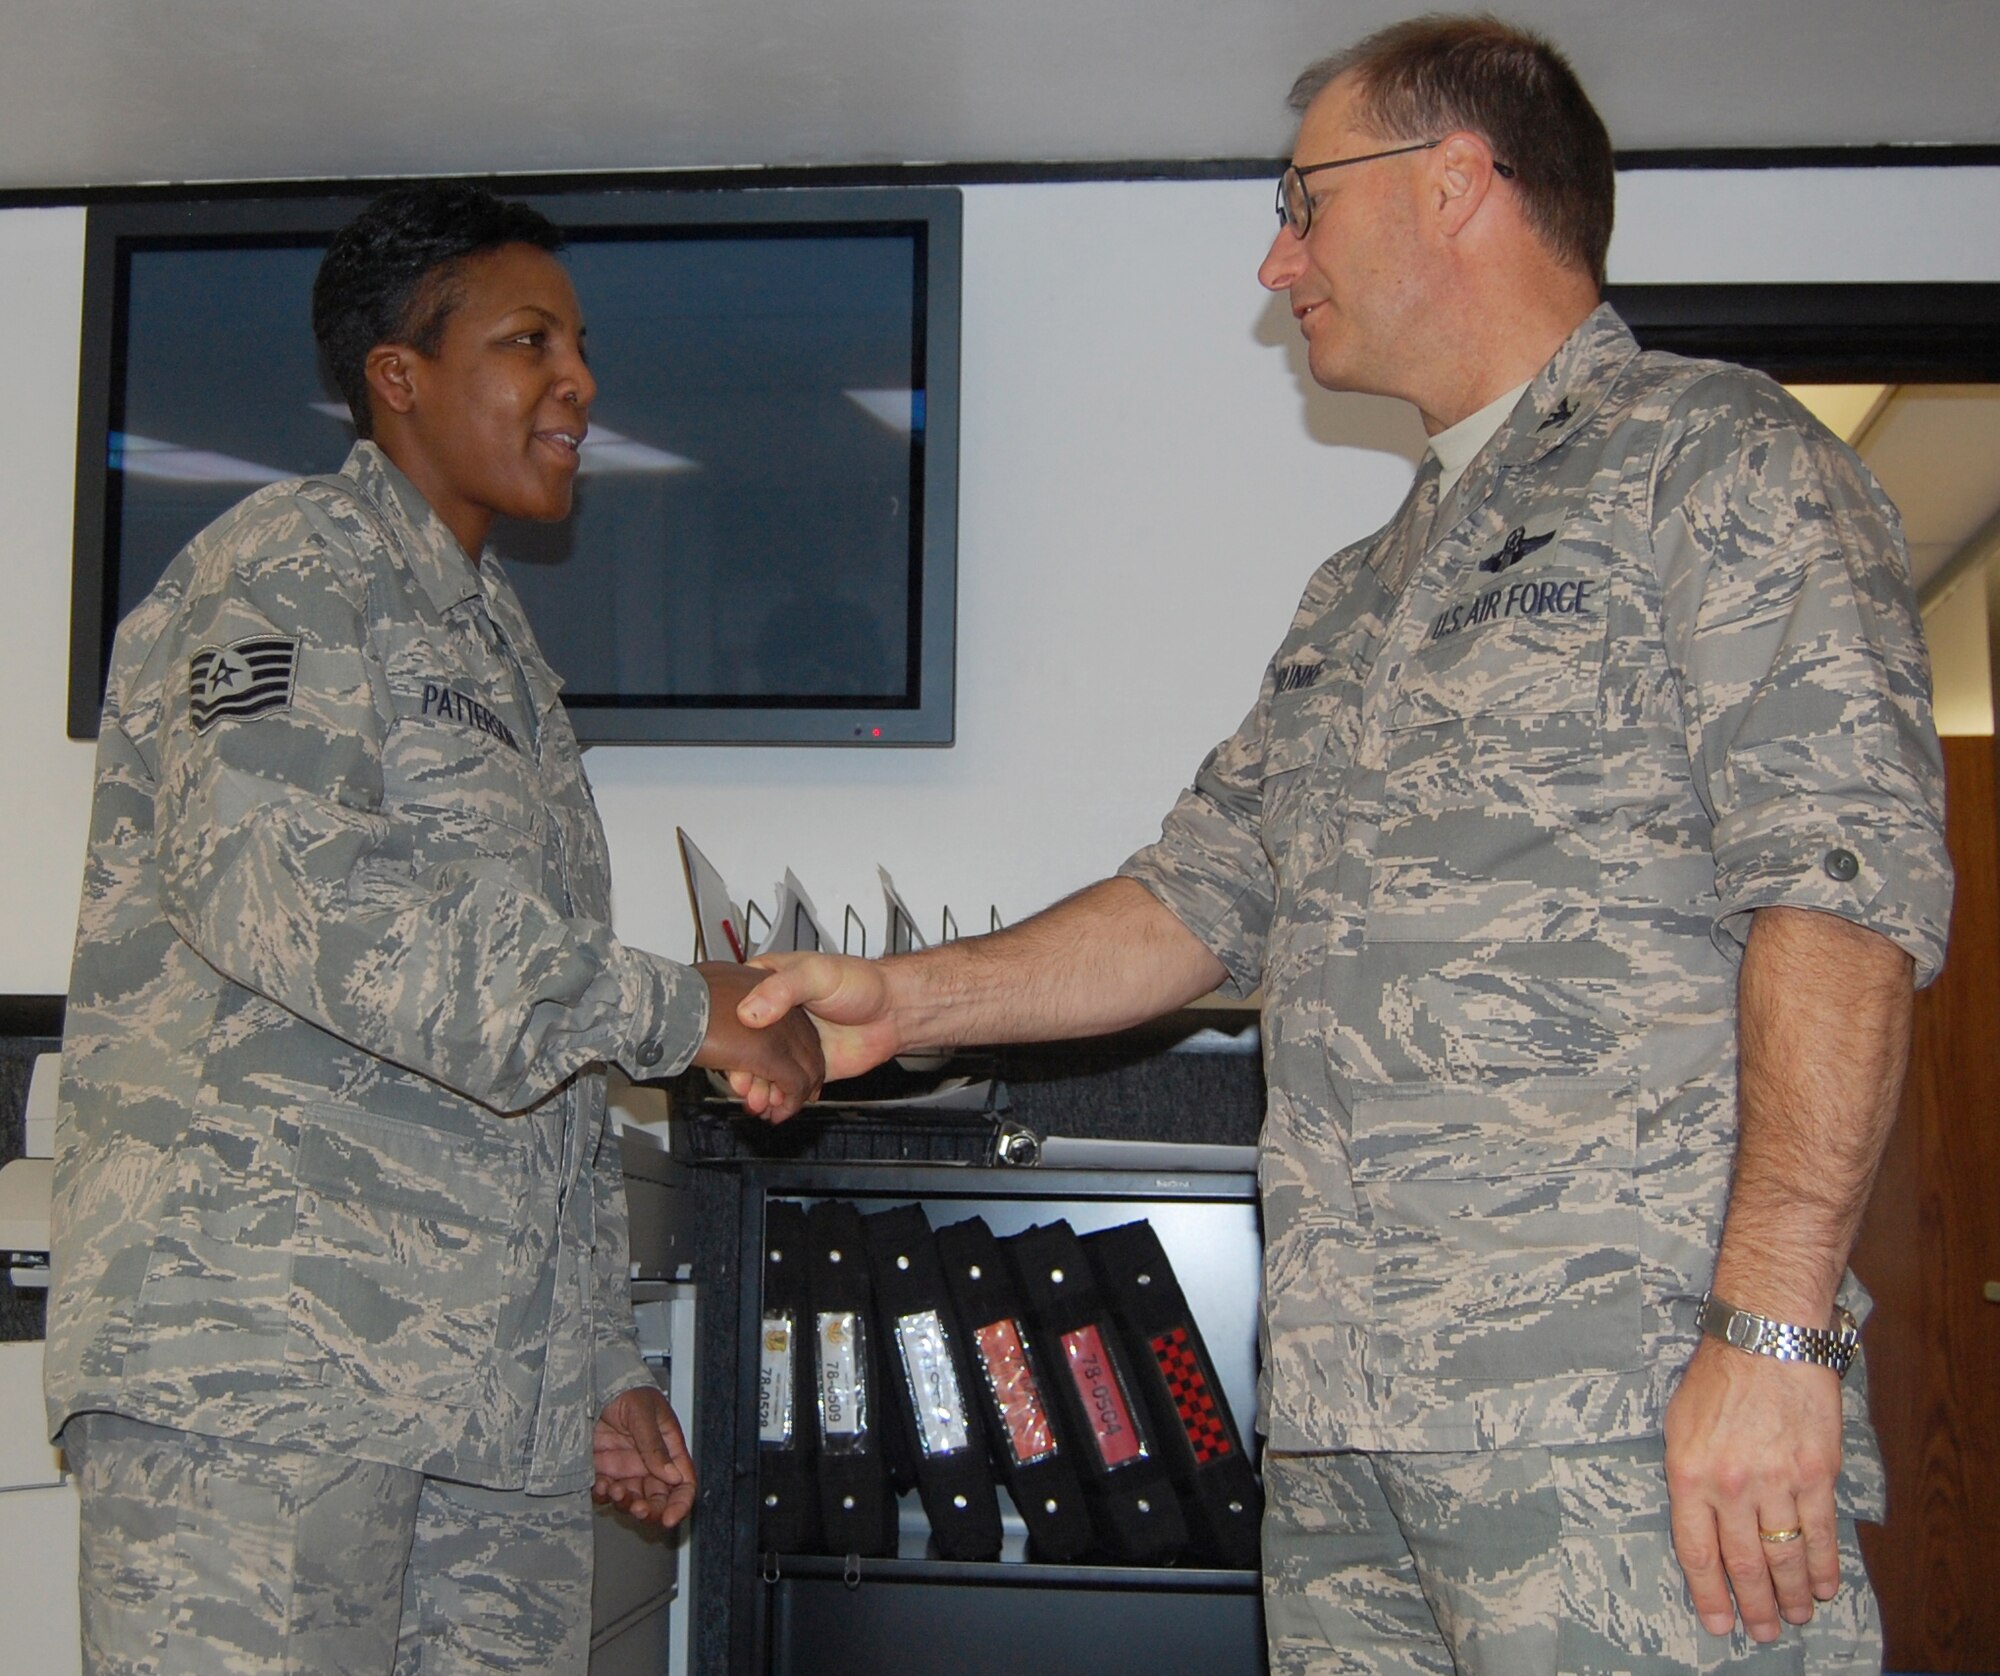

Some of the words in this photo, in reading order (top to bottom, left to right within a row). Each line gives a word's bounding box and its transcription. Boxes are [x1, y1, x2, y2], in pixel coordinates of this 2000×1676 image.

[1431, 605, 1463, 640] U.S.
[1463, 590, 1502, 628] AIR
[1504, 580, 1596, 617] FORCE
[421, 684, 521, 753] PATTERSON
[1082, 1353, 1123, 1436] 78-0504
